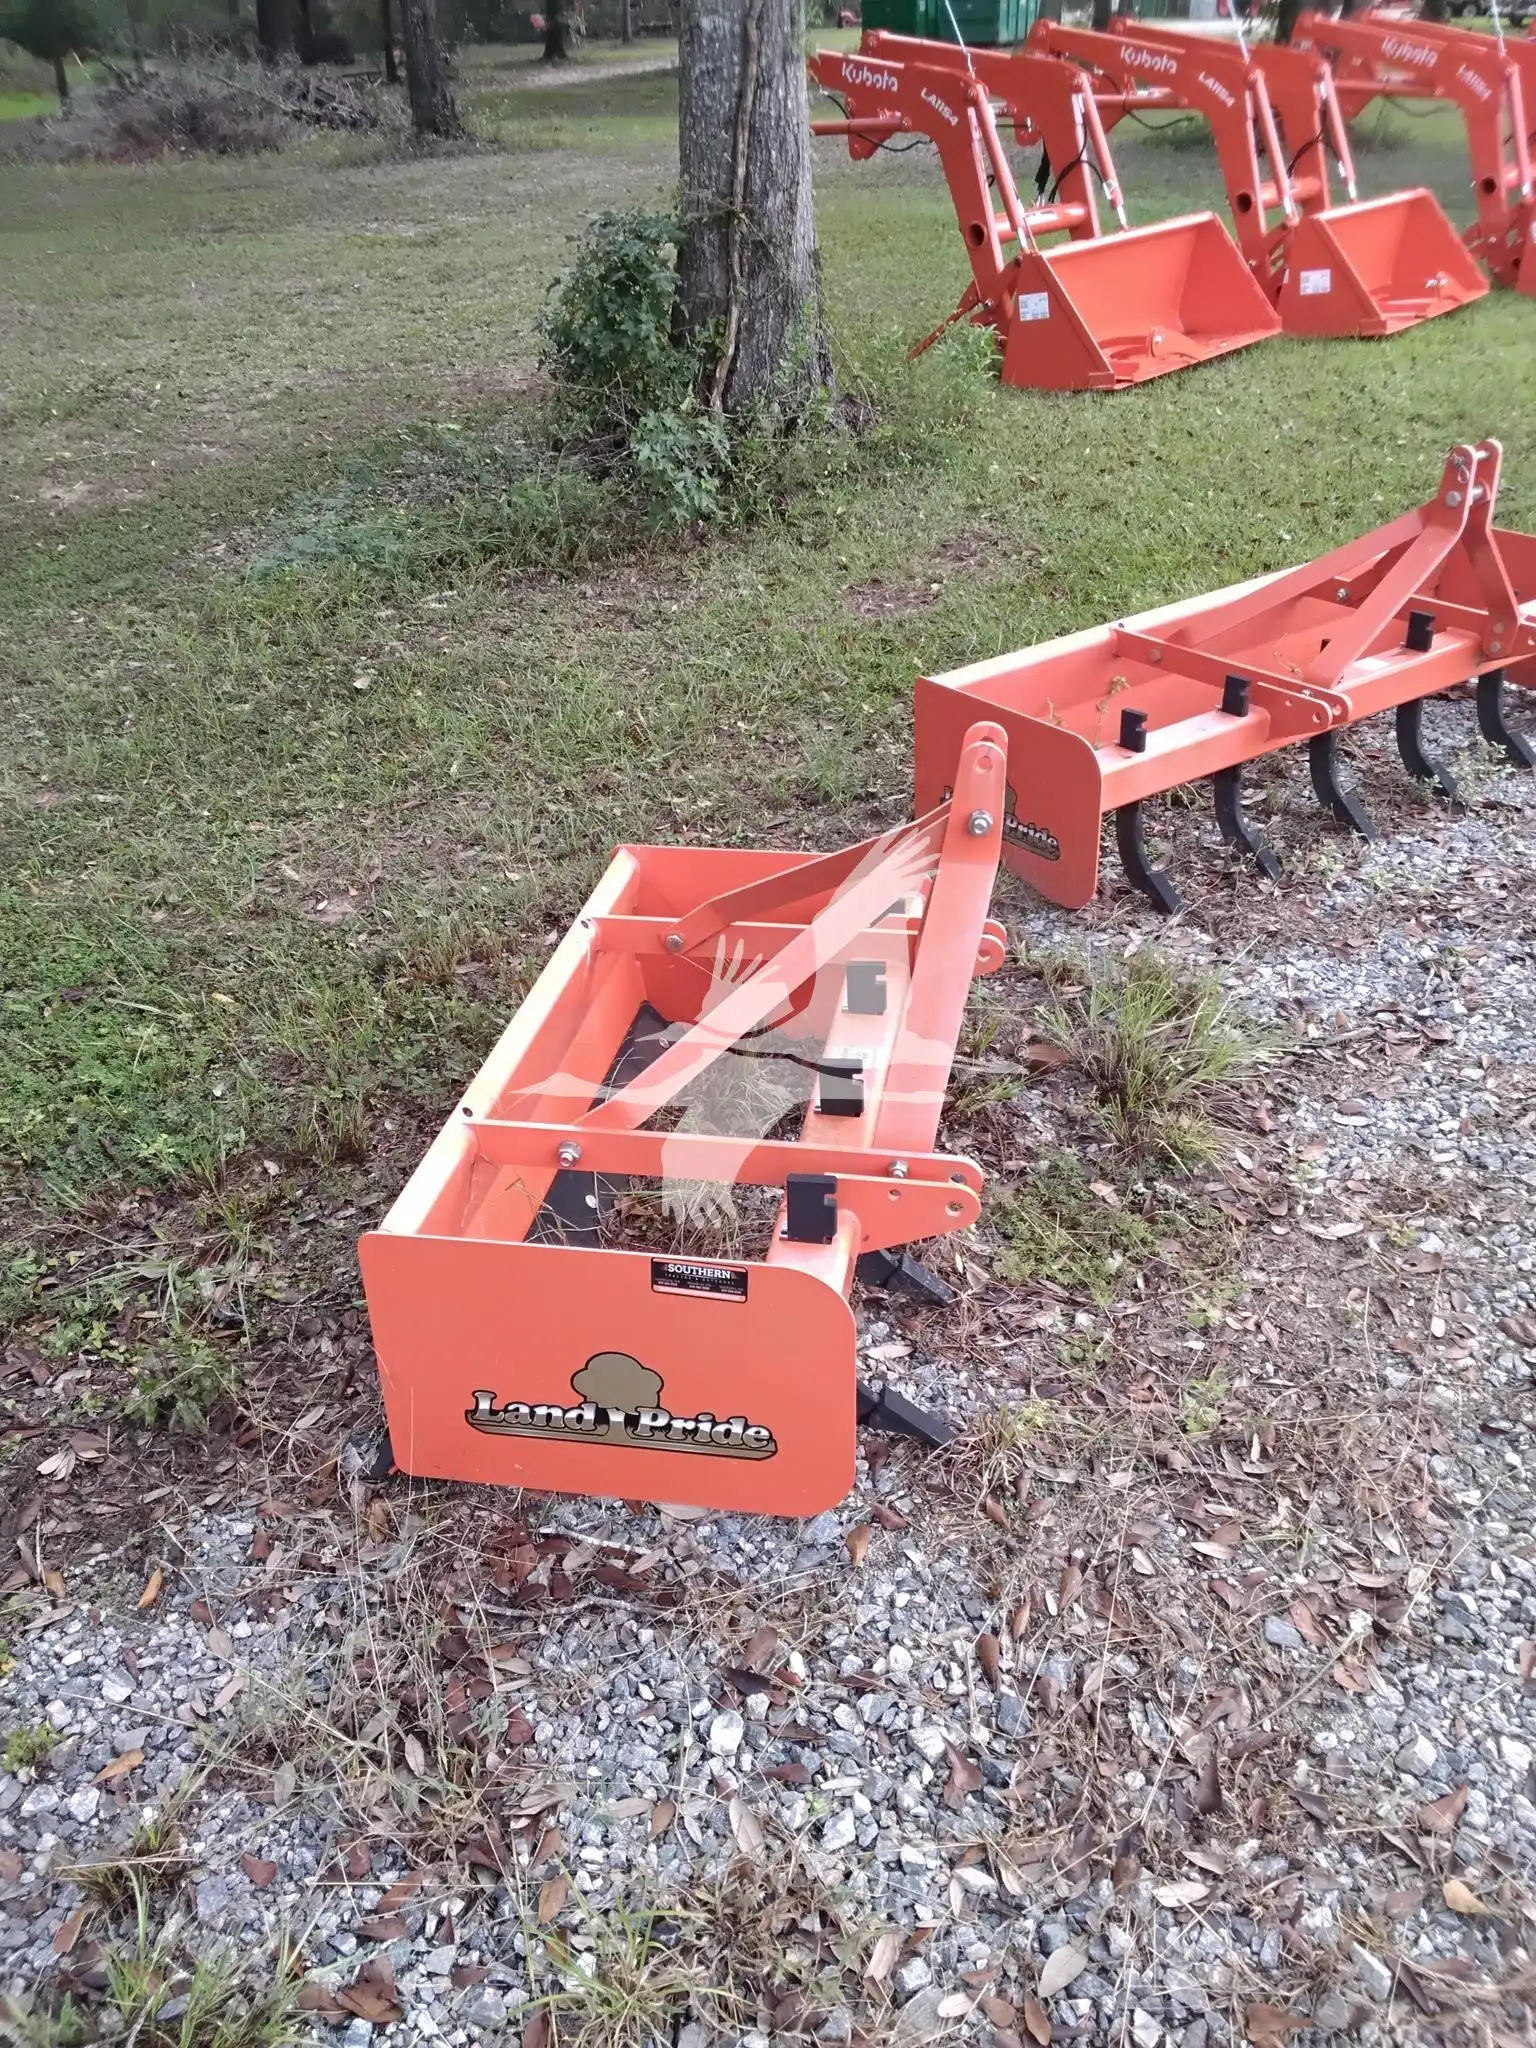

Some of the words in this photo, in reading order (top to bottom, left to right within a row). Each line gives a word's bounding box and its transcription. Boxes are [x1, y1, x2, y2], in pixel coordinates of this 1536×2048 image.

[1120, 45, 1178, 75] Kubota
[841, 61, 899, 93] Kubota
[920, 87, 959, 127] LA1154
[667, 1263, 731, 1280] SOUTHERN
[472, 1389, 599, 1432] Land
[634, 1406, 773, 1449] Pride
